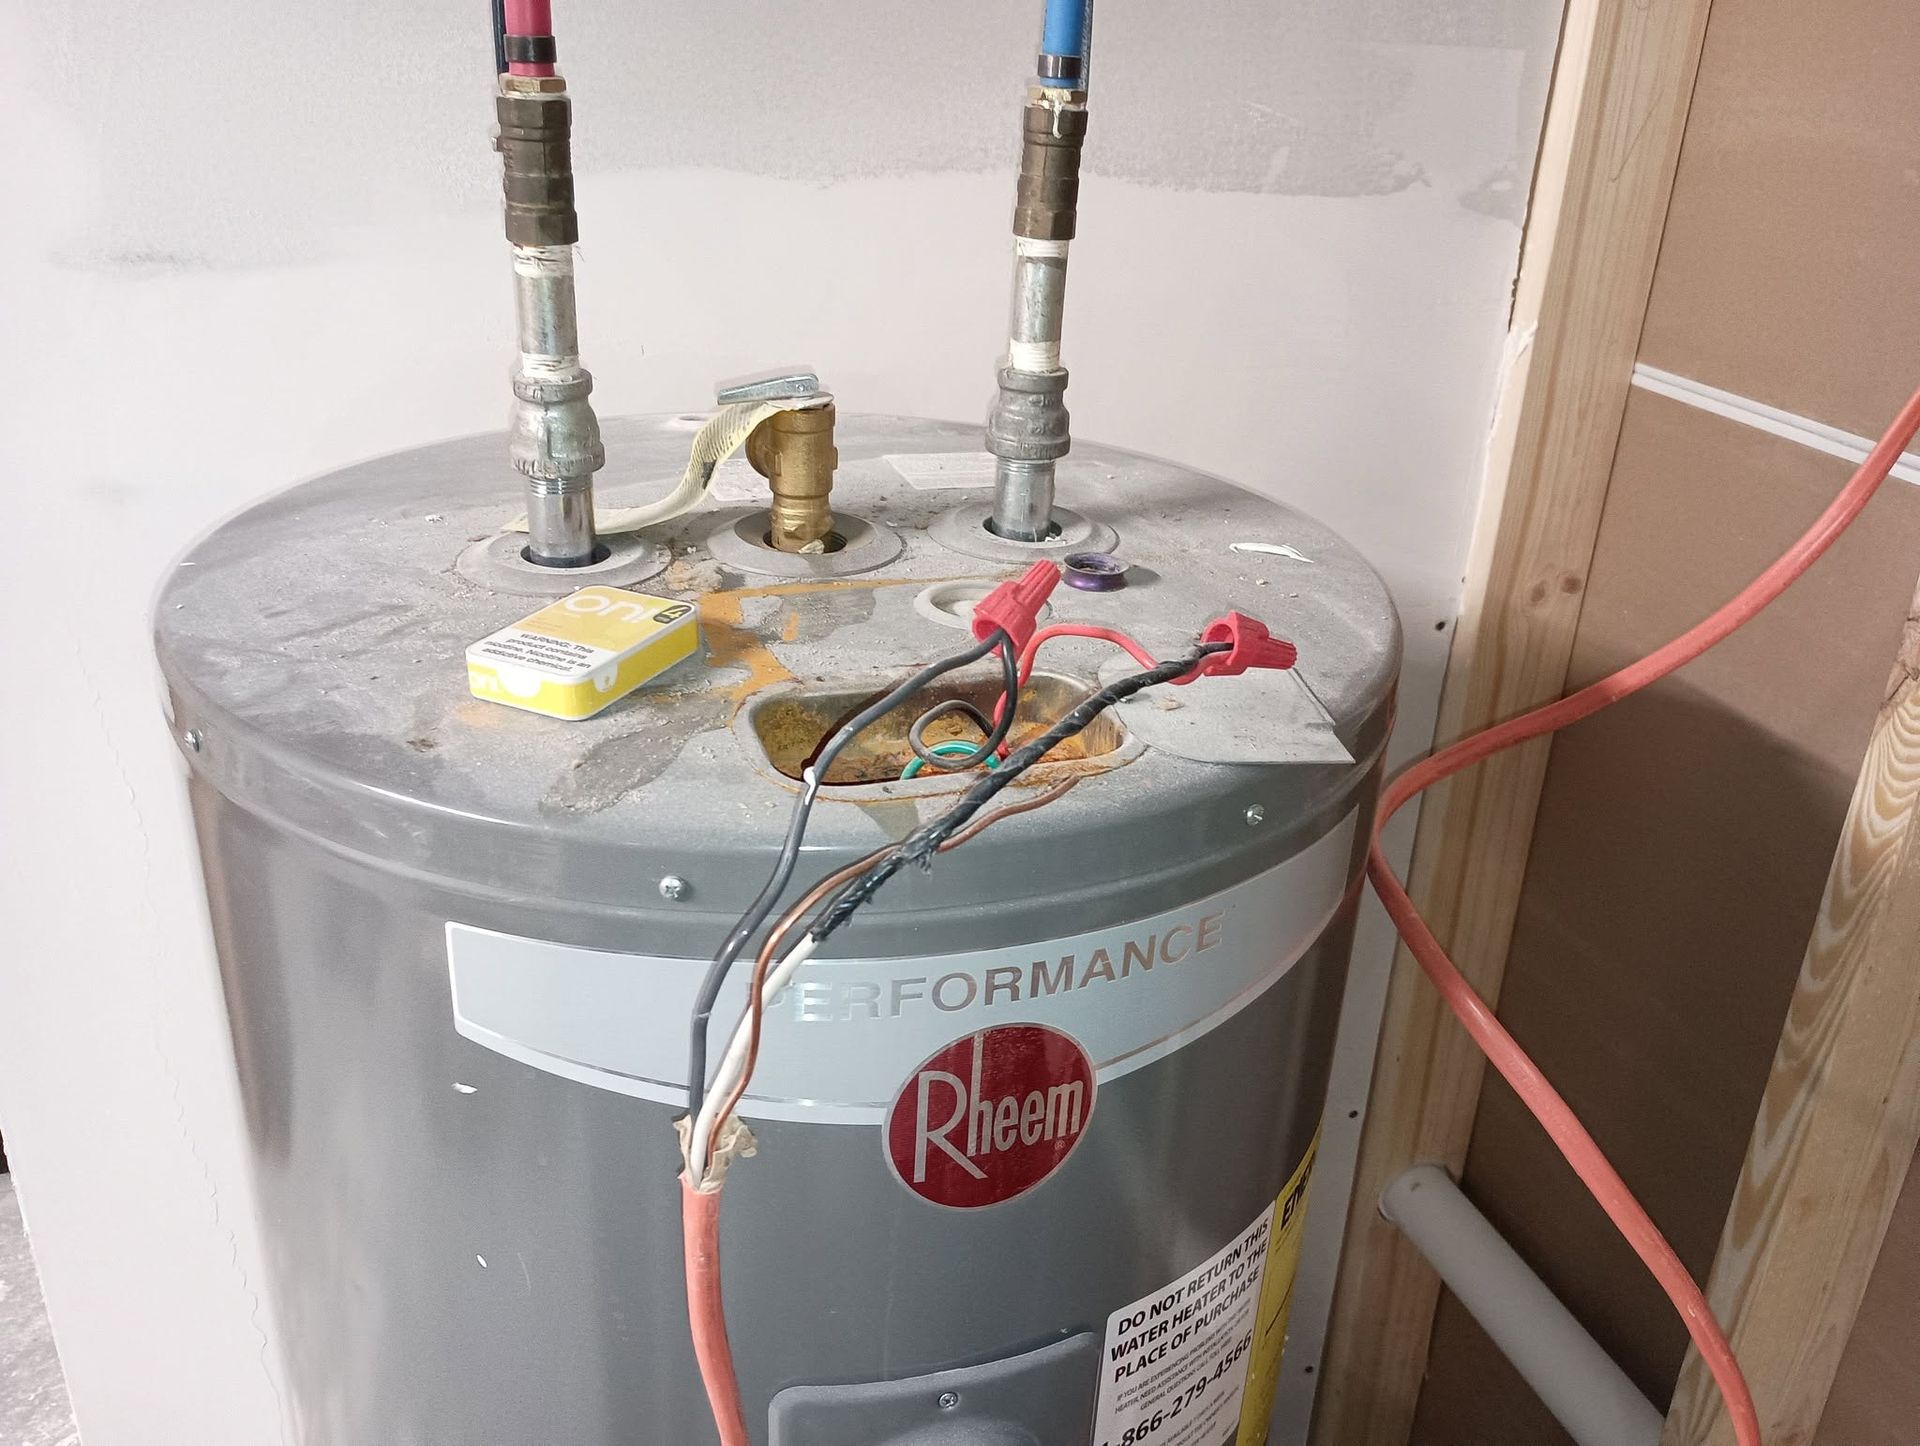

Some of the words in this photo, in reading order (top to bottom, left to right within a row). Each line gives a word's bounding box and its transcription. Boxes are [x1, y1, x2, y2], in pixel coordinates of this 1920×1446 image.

[662, 605, 689, 619] 4
[482, 648, 526, 660] addictive
[483, 640, 524, 653] nicotine.
[525, 649, 567, 662] Nicotine
[506, 638, 546, 650] product
[545, 647, 588, 660] contains
[521, 633, 573, 648] WARNING:
[573, 644, 595, 654] This
[913, 1031, 1084, 1183] Rheem
[1118, 1310, 1147, 1335] DO
[1149, 1287, 1185, 1320] NOT
[1186, 1243, 1242, 1298] RETURN
[1244, 1217, 1268, 1251] THIS
[1110, 1319, 1169, 1362] WATER
[1171, 1278, 1227, 1329] HEATER
[1228, 1262, 1245, 1286] TO
[1247, 1237, 1268, 1269] THE
[1114, 1342, 1168, 1383] PLACE
[1171, 1325, 1192, 1350] OF
[1194, 1265, 1260, 1335] PURCHASE
[1123, 1386, 1138, 1398] YOU
[1138, 1378, 1150, 1391] ARE
[1140, 1386, 1157, 1400] NEED
[1140, 1391, 1166, 1410] GENERAL
